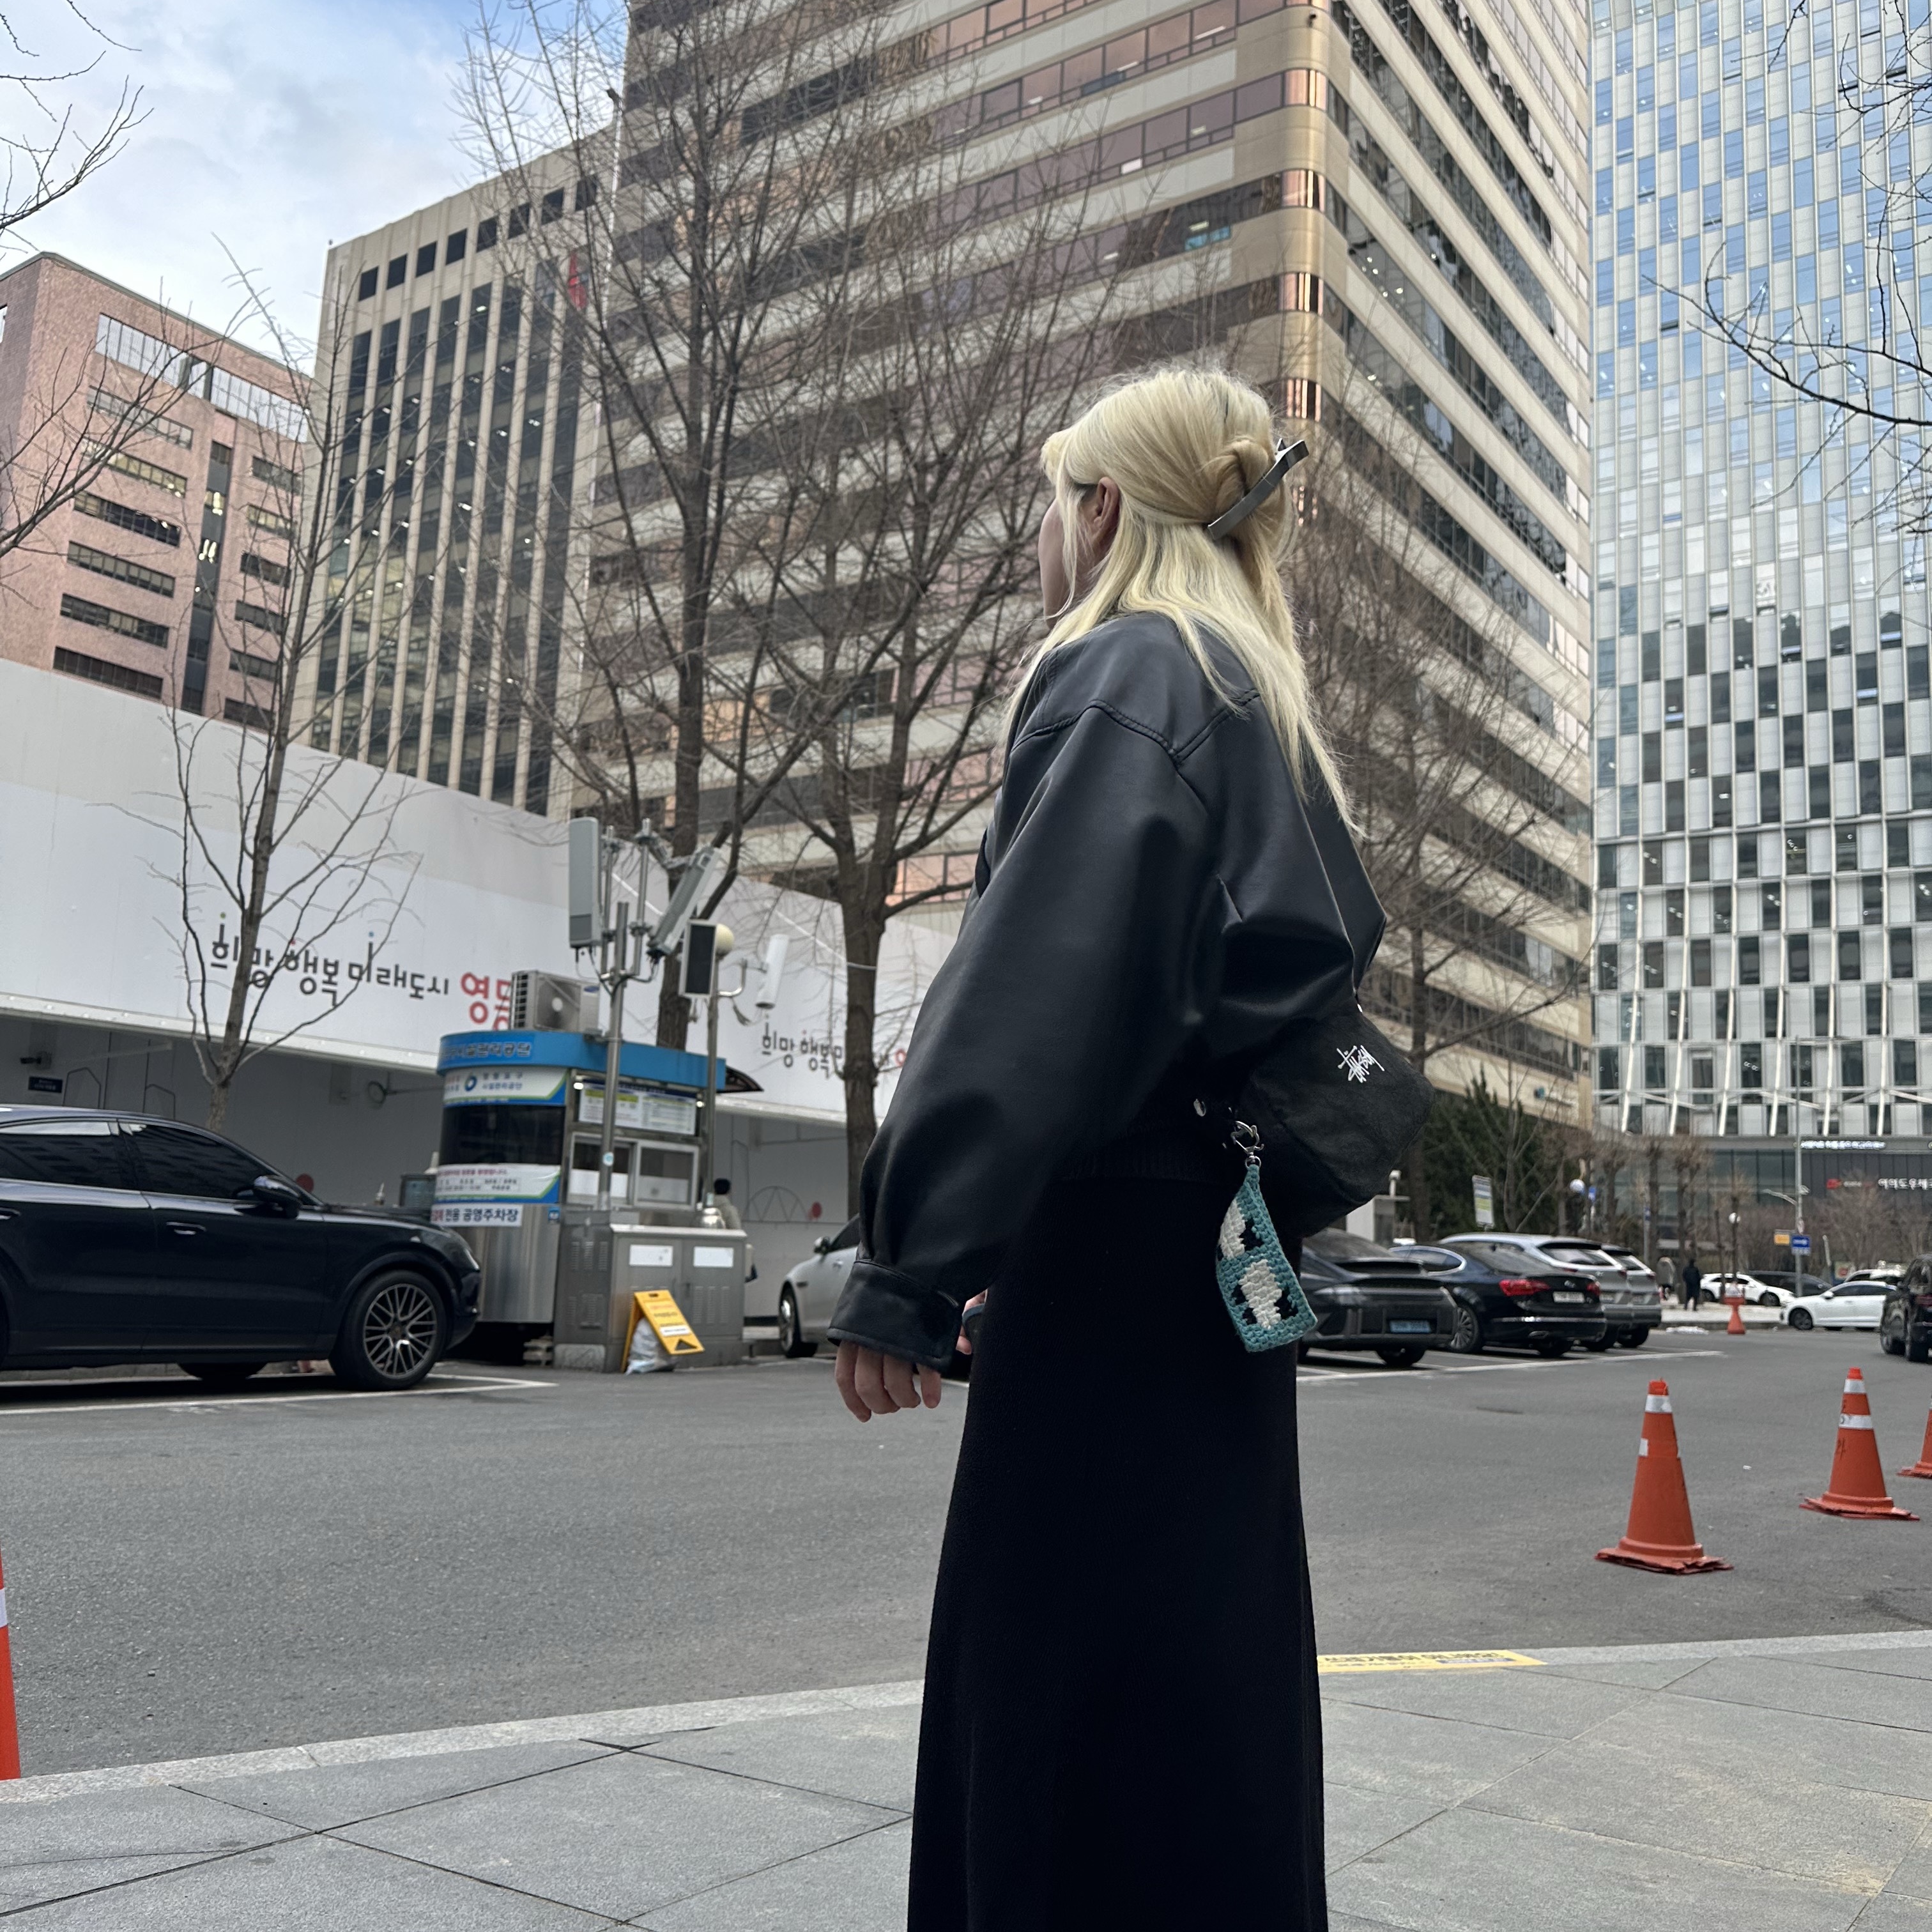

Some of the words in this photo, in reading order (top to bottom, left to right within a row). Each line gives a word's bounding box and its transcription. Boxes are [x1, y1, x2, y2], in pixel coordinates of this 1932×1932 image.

[211, 912, 273, 989] 희망
[284, 939, 339, 1008] 행복
[348, 931, 449, 999] 미래도시
[762, 1014, 795, 1068] 희망
[463, 1208, 518, 1222] 공영주차장
